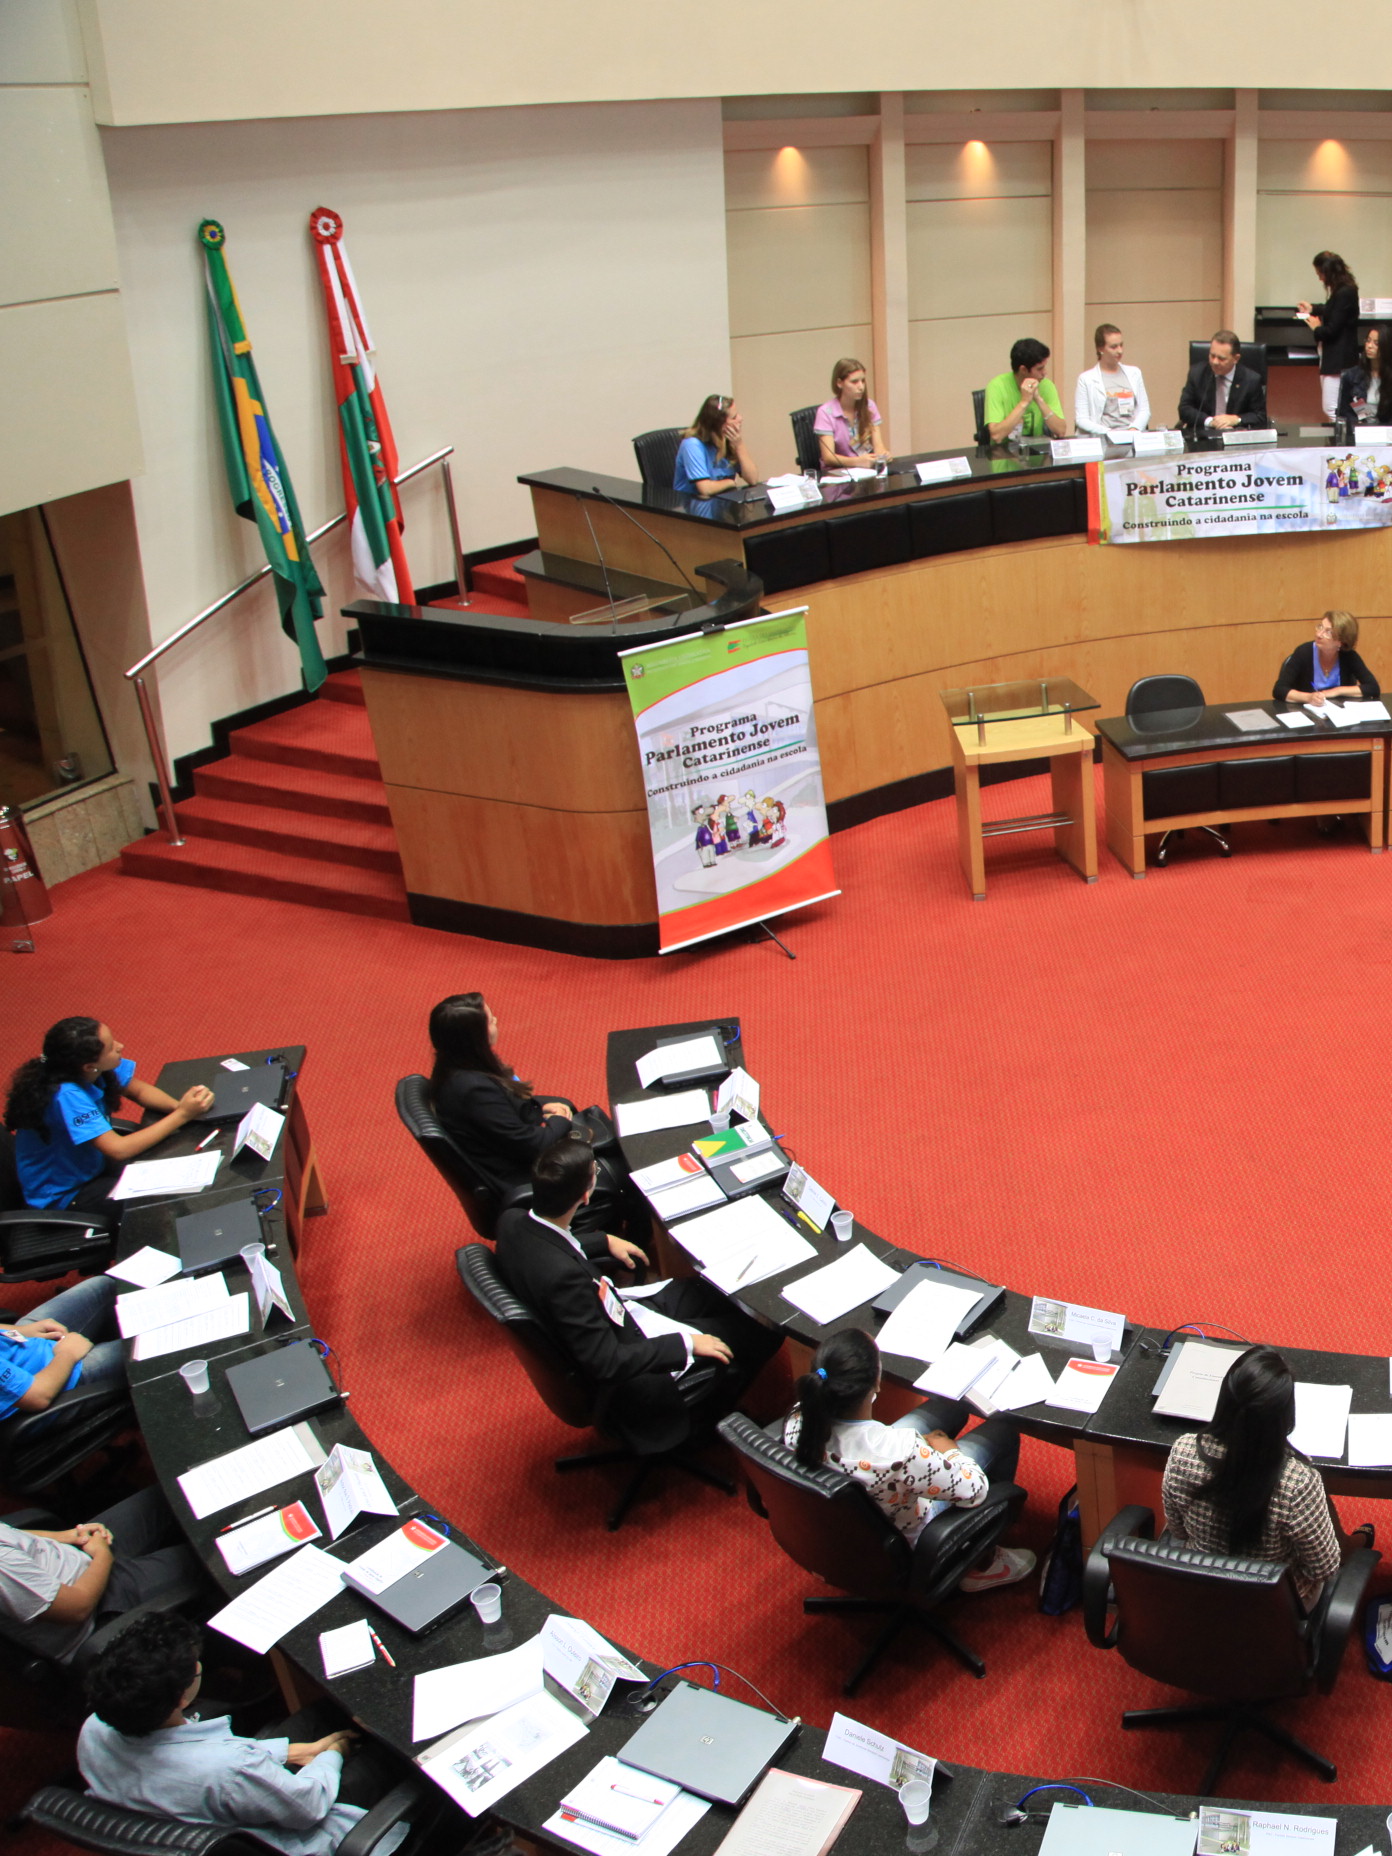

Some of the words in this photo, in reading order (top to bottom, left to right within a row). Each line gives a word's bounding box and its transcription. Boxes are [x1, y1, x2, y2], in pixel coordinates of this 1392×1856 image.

[1176, 460, 1252, 476] Programa
[1125, 475, 1237, 497] Parlamento
[1241, 472, 1304, 489] Jovem
[1165, 492, 1265, 508] Catarinense
[1122, 517, 1193, 530] Construindo
[1203, 513, 1257, 524] cidadania
[1259, 513, 1274, 521] na
[1275, 510, 1309, 520] escola
[690, 712, 758, 738] Programa
[645, 731, 746, 766] Parlamento
[749, 712, 800, 738] Jovem
[682, 738, 771, 769] Catarinense
[647, 774, 710, 798] Construindo
[720, 758, 765, 778] cidadania
[766, 754, 779, 764] na
[780, 745, 808, 760] escola
[3, 870, 34, 885] PAPEL
[1252, 1821, 1282, 1830] Raphael
[1293, 1825, 1329, 1836] Rodrigues
